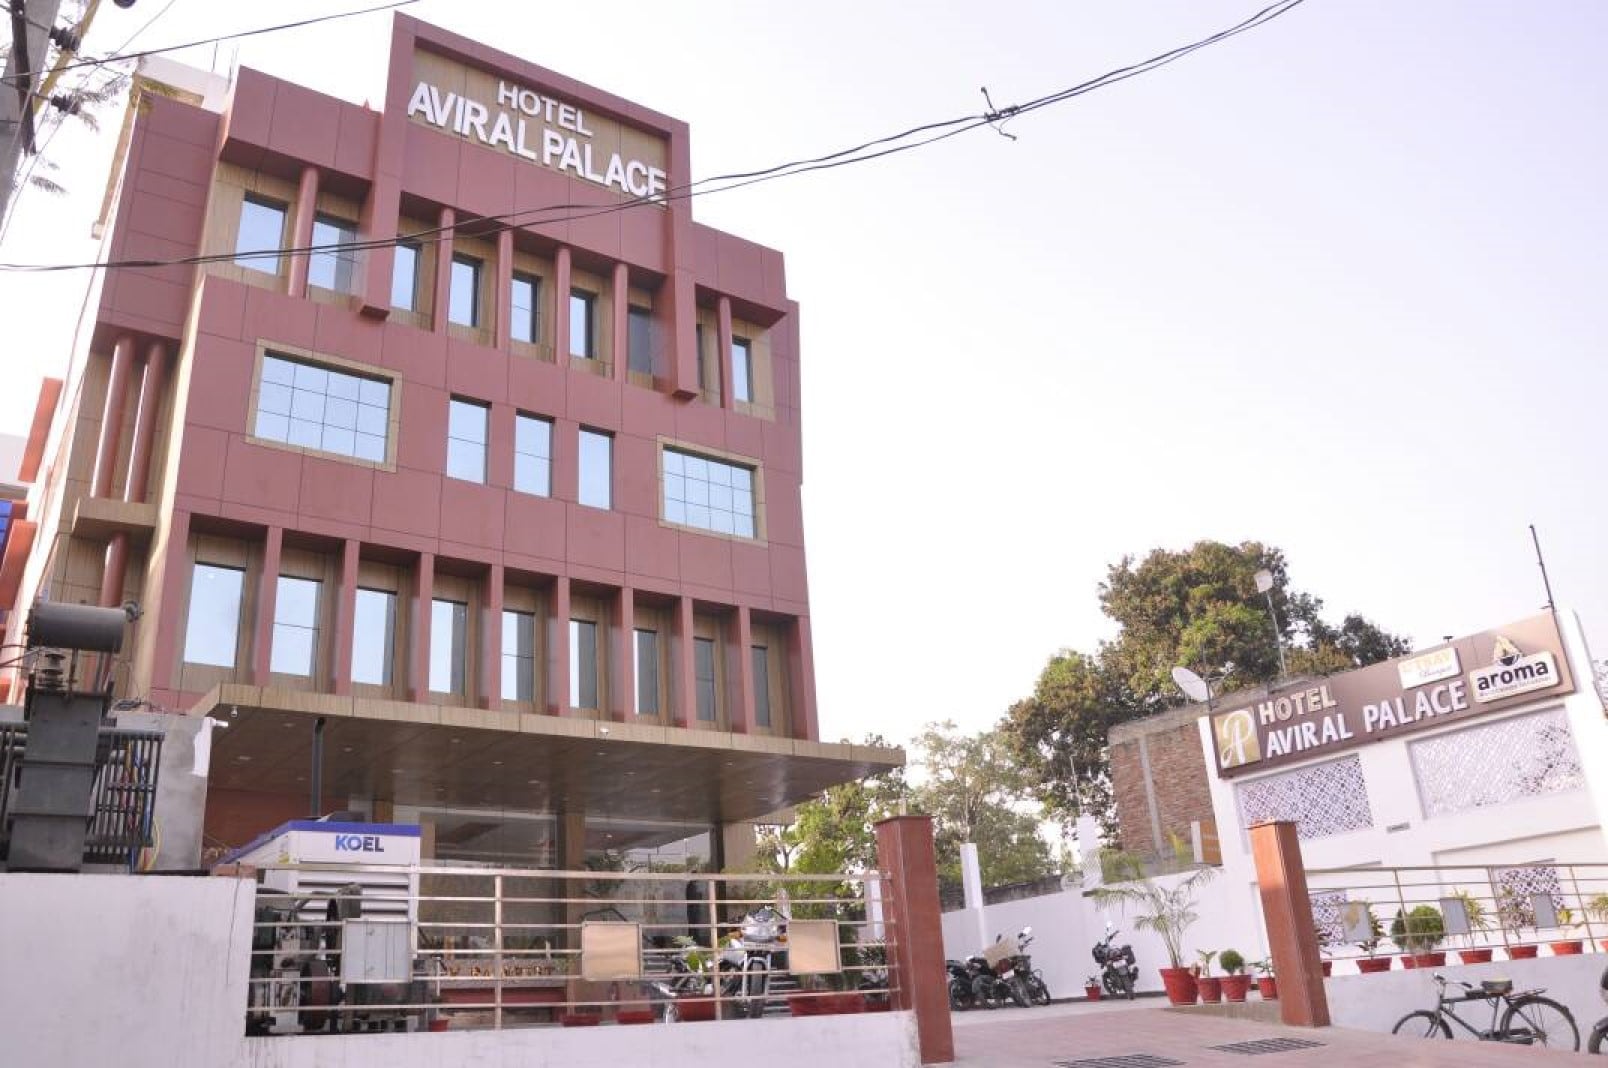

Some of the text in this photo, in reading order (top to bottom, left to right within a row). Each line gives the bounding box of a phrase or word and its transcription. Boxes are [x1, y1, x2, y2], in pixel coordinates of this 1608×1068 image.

[498, 80, 592, 137] HOTEL
[407, 81, 667, 205] AVIRAL PALACE
[1476, 660, 1549, 691] aroma
[1259, 685, 1337, 725] HOTEL
[1266, 713, 1353, 758] AVIRAL
[1363, 680, 1468, 733] PALACE
[335, 834, 385, 852] KOEL
